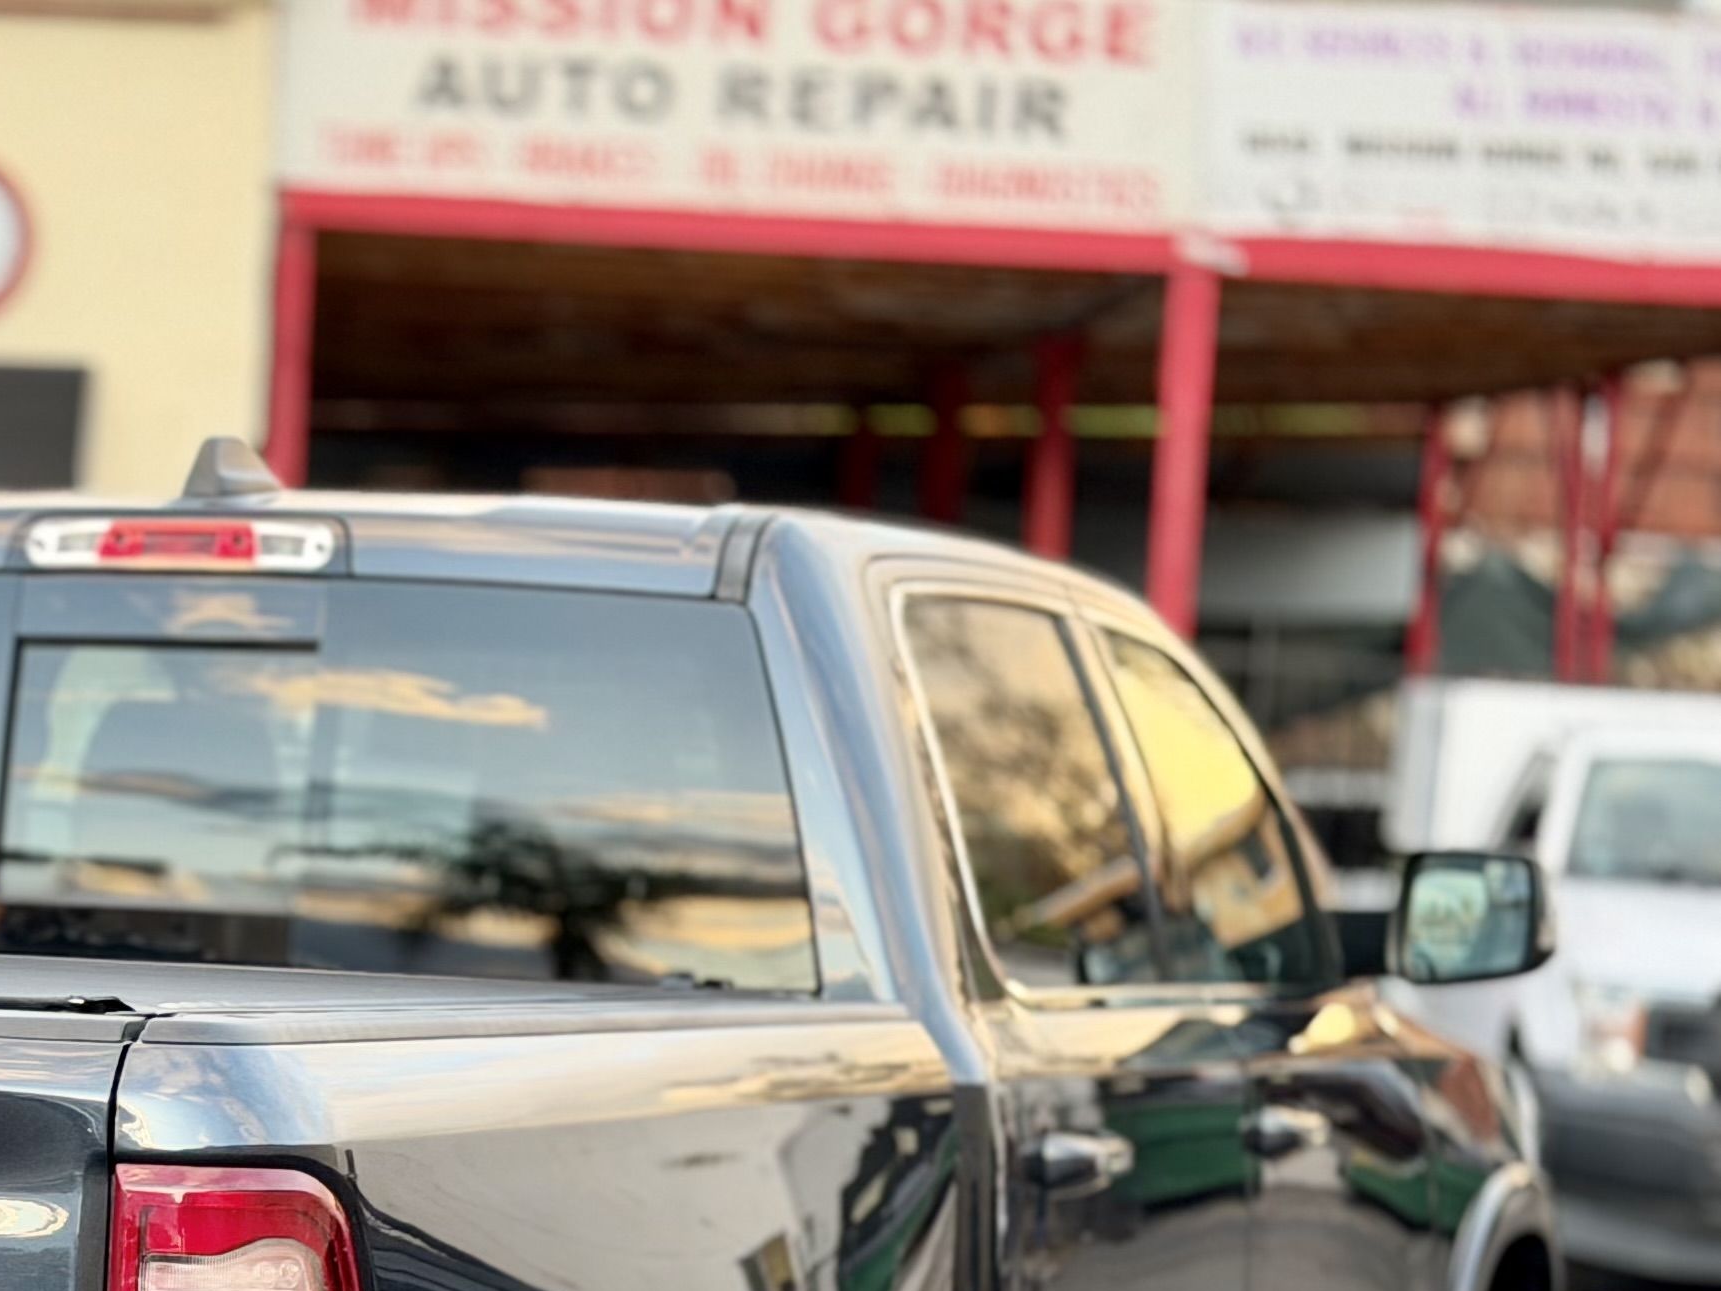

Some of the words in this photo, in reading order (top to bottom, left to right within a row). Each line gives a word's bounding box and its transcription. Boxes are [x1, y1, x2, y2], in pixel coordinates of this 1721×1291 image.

[809, 0, 1153, 64] GORGE
[419, 55, 675, 120] AUTO
[717, 64, 1071, 140] REPAIR
